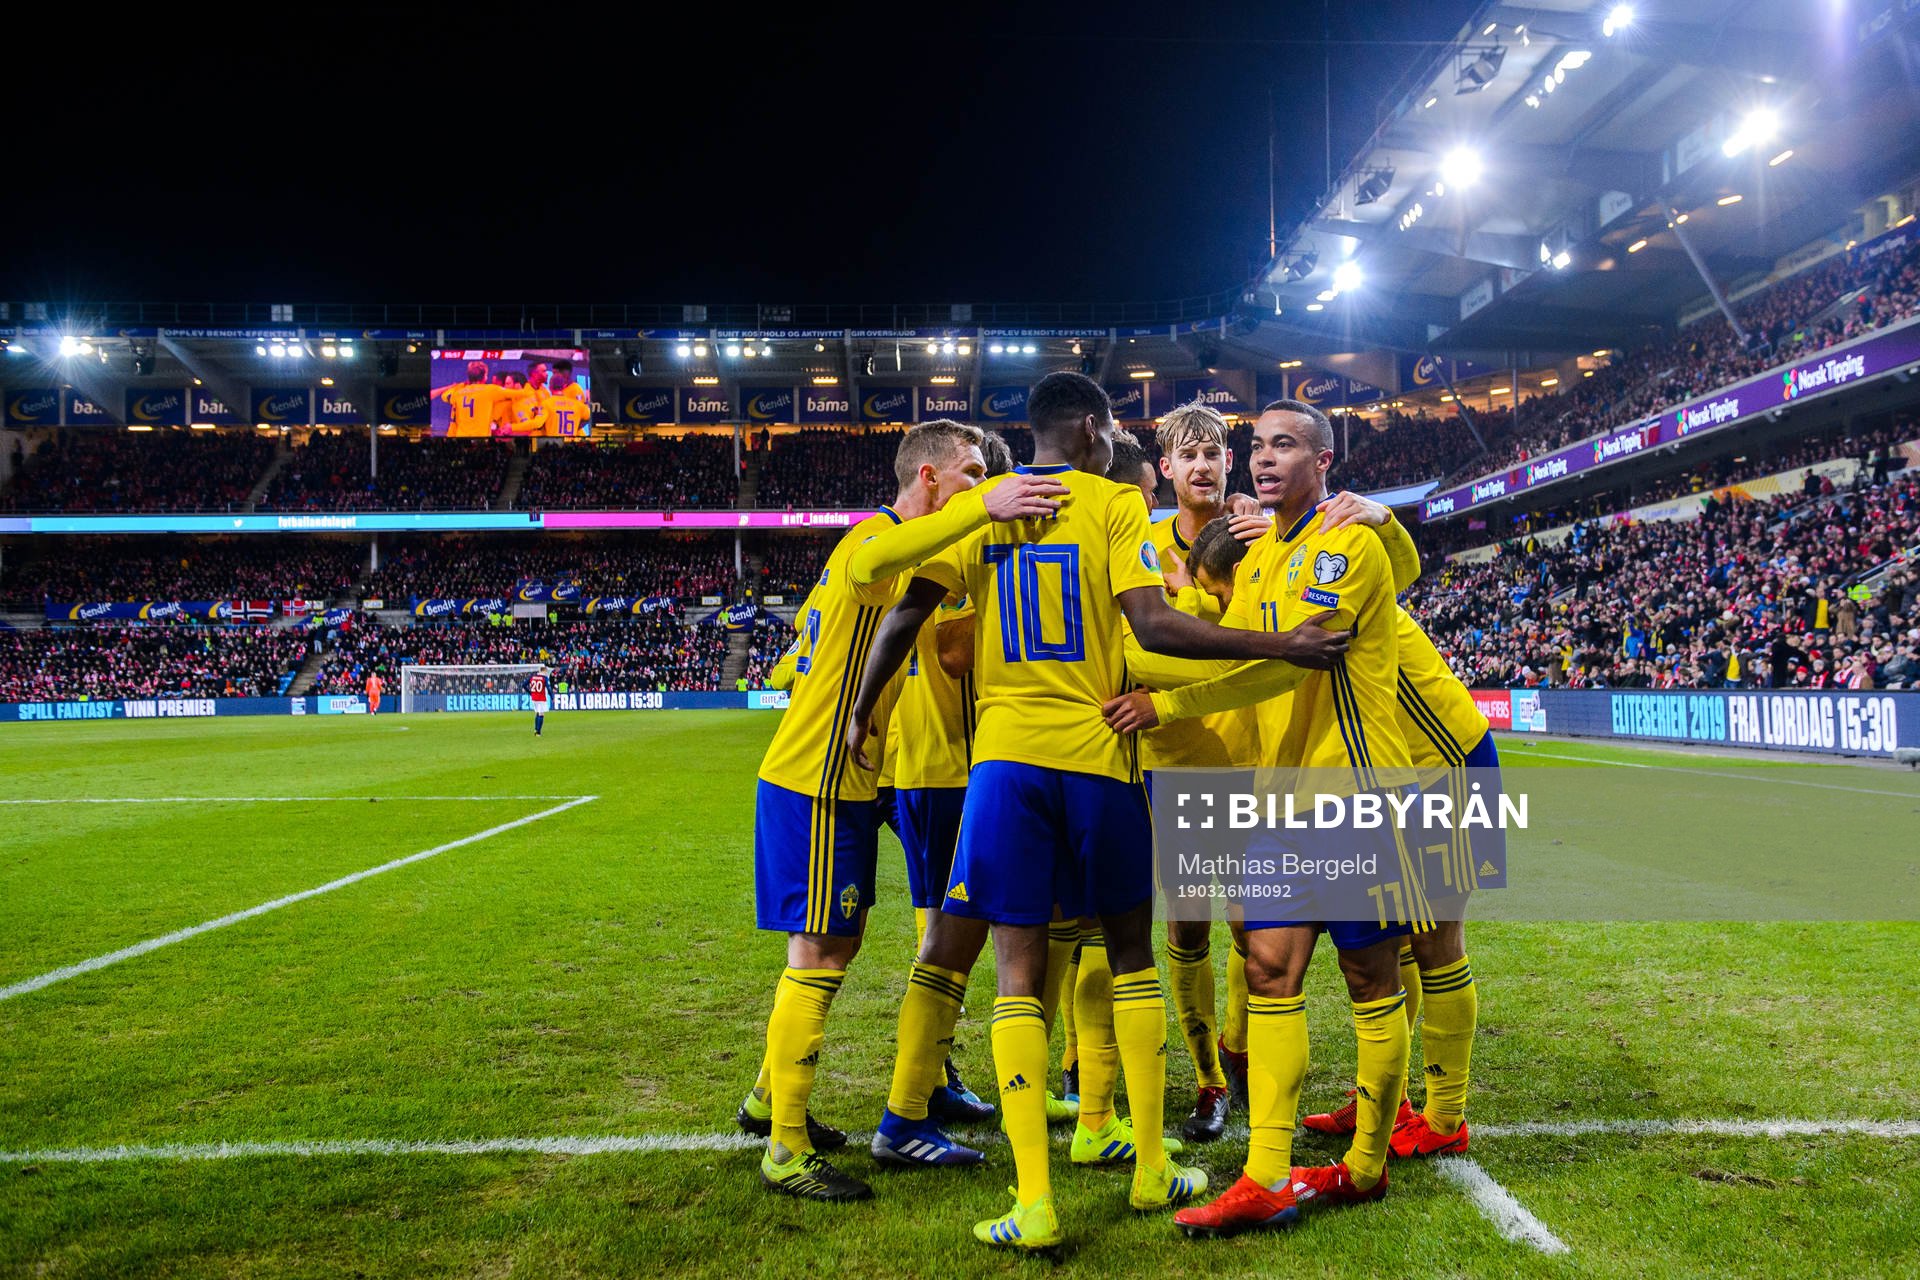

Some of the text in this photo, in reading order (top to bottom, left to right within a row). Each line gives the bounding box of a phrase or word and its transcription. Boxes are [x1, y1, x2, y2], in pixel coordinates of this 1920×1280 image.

[787, 330, 800, 338] OG
[1798, 354, 1865, 391] Norsk Tipping
[1306, 377, 1339, 397] Bendit
[462, 396, 475, 418] 4
[637, 394, 670, 412] Bendit
[759, 394, 791, 412] Bendit
[807, 396, 849, 412] bama
[875, 393, 907, 410] Bendit
[926, 396, 968, 412] bama
[993, 391, 1024, 410] Bendit
[1709, 397, 1739, 424] Tipping
[556, 411, 575, 435] 16
[983, 543, 1086, 663] 10
[1308, 590, 1339, 605] RESPECT
[80, 602, 112, 619] Bendit
[150, 601, 180, 619] Bendit
[426, 599, 456, 616] Bendit
[729, 604, 758, 622] Bendit
[531, 680, 543, 693] 20
[19, 702, 55, 720] SPILL
[57, 701, 114, 719] FANTASY
[124, 700, 156, 717] VINN
[158, 699, 216, 716] PREMIER
[447, 694, 520, 711] ELITESERIEN
[554, 693, 577, 710] FRA
[580, 692, 627, 710] LØRDAG
[629, 692, 663, 709] 15:30
[1611, 694, 1898, 752] ELITESERIEN 2019 FRA LØRDAG 15:30
[1367, 881, 1407, 930] 11
